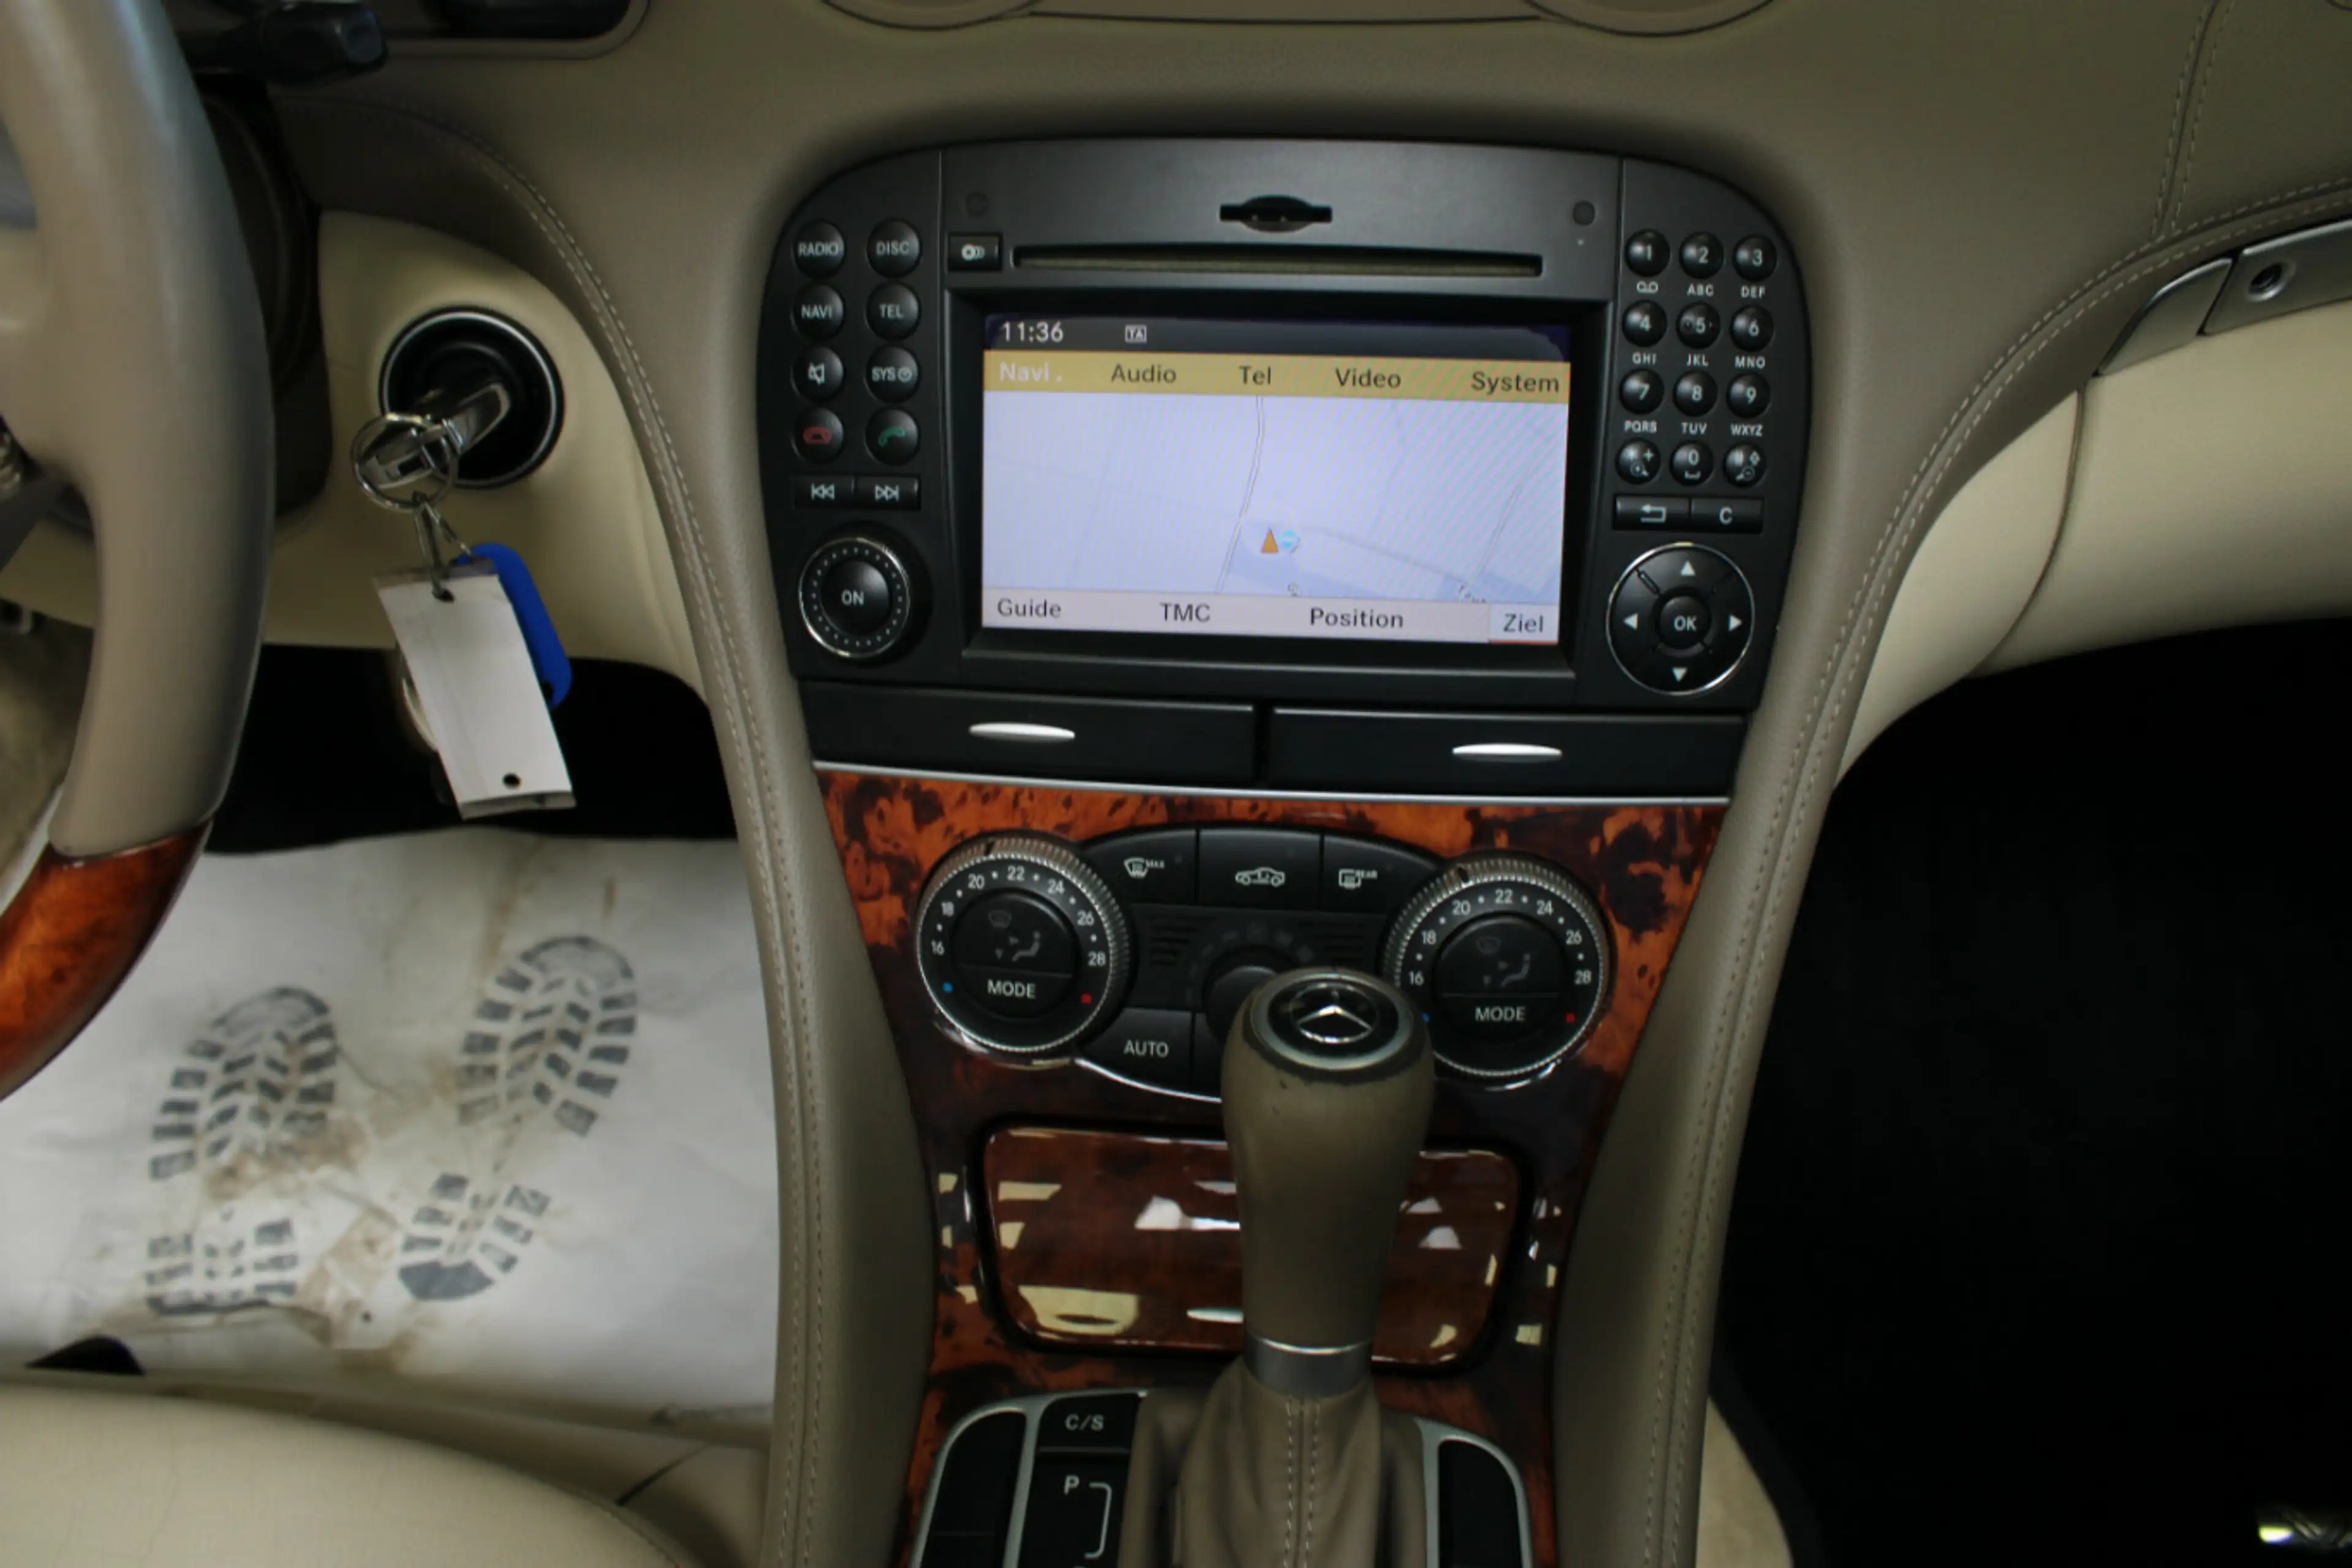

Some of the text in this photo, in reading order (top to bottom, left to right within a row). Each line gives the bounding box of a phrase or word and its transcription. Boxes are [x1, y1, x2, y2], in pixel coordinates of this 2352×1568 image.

[798, 242, 839, 257] RADIO
[876, 241, 910, 256] DISC
[1645, 246, 1653, 260] 1
[1698, 247, 1708, 263] 2
[1752, 249, 1763, 266] 3
[1687, 284, 1714, 296] ABC
[1741, 285, 1765, 298] DEF
[801, 304, 832, 318] NAVI
[880, 304, 904, 318] TEL
[1640, 315, 1651, 331] 4
[1695, 317, 1706, 333] 5
[1749, 320, 1759, 336] 6
[1001, 322, 1064, 343] 11:36
[1632, 352, 1657, 364] GHI
[1686, 353, 1708, 366] JKL
[1735, 356, 1765, 369] MNO
[871, 366, 895, 382] SYS
[1111, 363, 1177, 384] Audio
[1239, 366, 1271, 385] Tel
[1335, 368, 1401, 389] Video
[1471, 371, 1559, 396] System
[1639, 383, 1649, 400] 7
[1692, 385, 1702, 402] 8
[1746, 386, 1757, 405] 9
[1624, 420, 1657, 434] PQRS
[1681, 421, 1707, 435] TUV
[1730, 424, 1763, 437] WXYZ
[1688, 449, 1700, 466] 0
[1719, 507, 1733, 525] C
[841, 590, 864, 606] ON
[997, 598, 1544, 633] Guide TMC Position Ziel
[1673, 615, 1697, 631] OK
[931, 865, 1106, 968] 16 18 20 22 24 26 28
[1409, 889, 1592, 986] 16 18 20 22 24 26 28
[987, 979, 1036, 1000] MODE
[1475, 1006, 1526, 1022] MODE
[1124, 1039, 1169, 1058] AUTO
[1065, 1414, 1104, 1431] C/S
[1064, 1475, 1080, 1495] P
